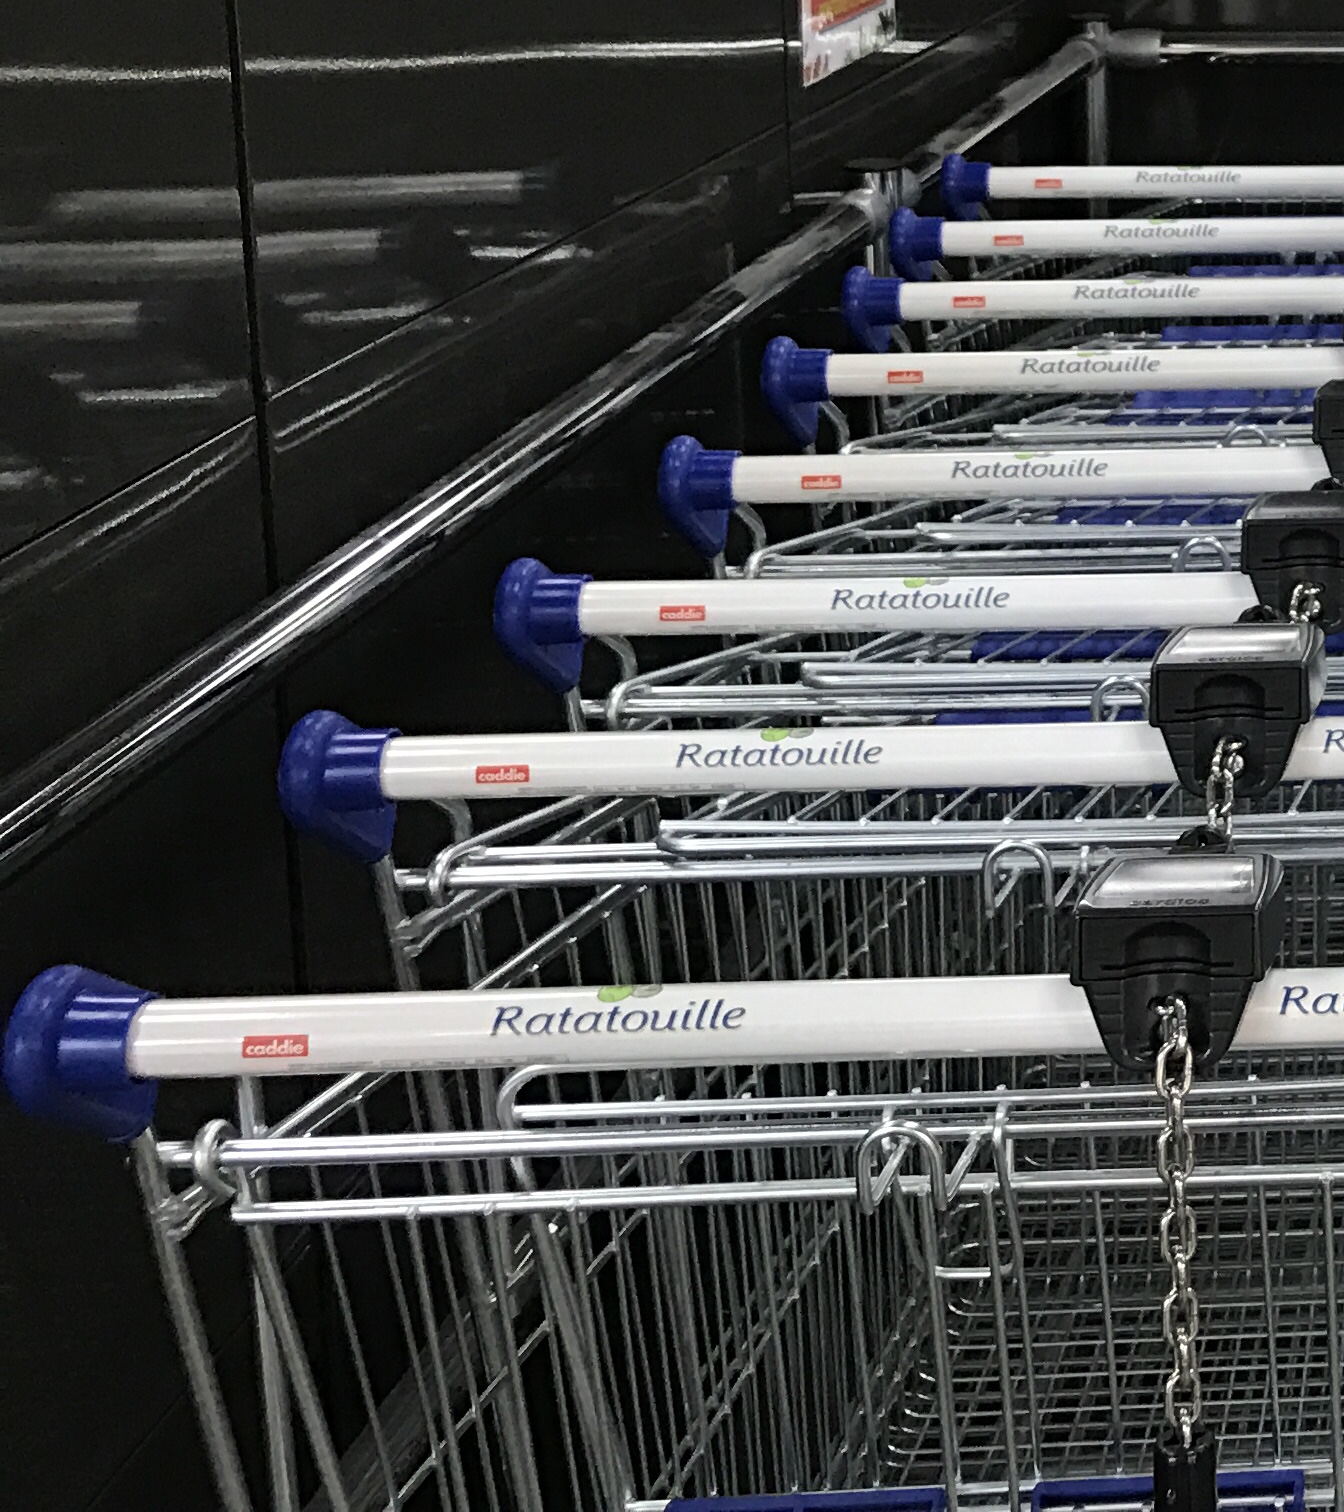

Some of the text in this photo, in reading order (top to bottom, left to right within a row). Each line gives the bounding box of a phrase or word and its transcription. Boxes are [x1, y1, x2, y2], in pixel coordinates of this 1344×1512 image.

[1103, 223, 1219, 239] Ratatouille
[1074, 282, 1199, 300] Ratatouille
[1021, 354, 1160, 375] Ratatouille
[951, 458, 1109, 481] Ratatouille
[830, 586, 1010, 612] Ratatouille
[676, 738, 884, 771] Ratatouille
[478, 768, 526, 782] caddie
[489, 995, 746, 1039] Ratatouille
[246, 1039, 303, 1055] caddie
